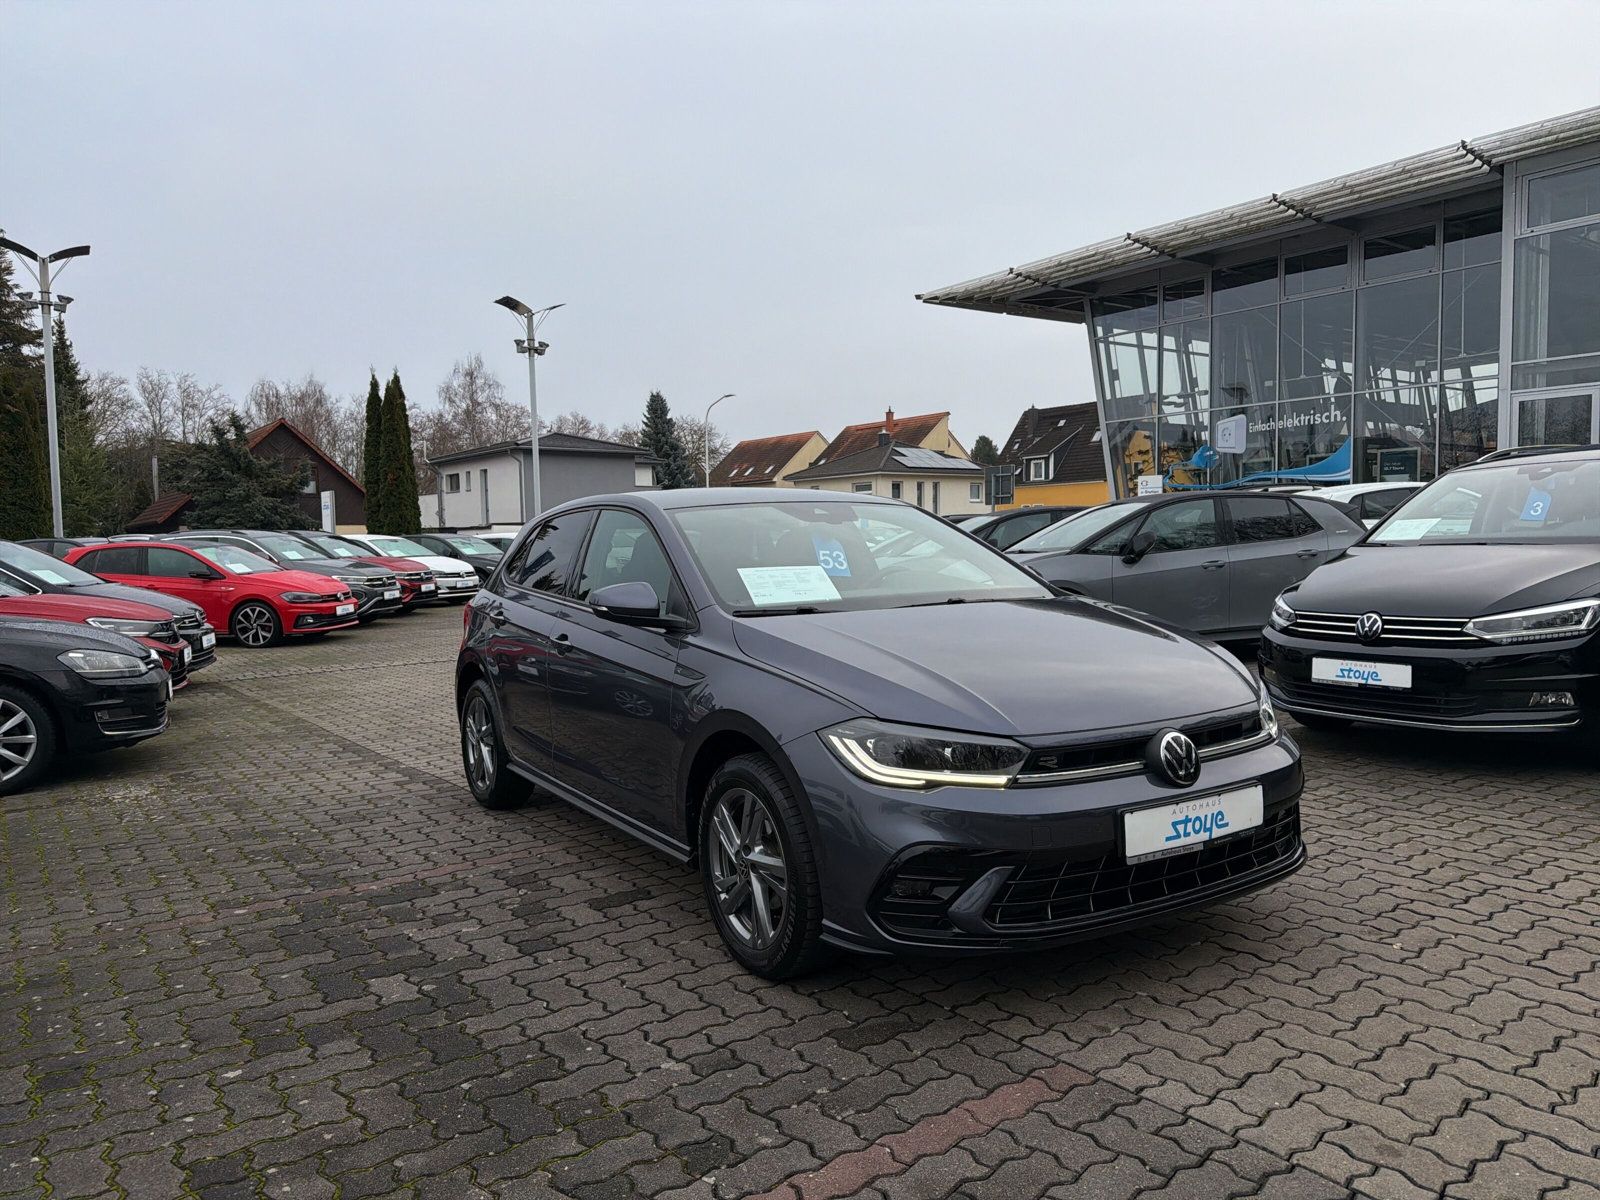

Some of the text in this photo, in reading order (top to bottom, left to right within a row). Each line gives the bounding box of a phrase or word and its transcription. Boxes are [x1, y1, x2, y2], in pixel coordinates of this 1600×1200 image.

[1248, 404, 1347, 433] Einfach elektrisch.
[1530, 502, 1543, 516] 3
[819, 550, 847, 570] 53
[1172, 798, 1222, 815] AUTOHAUS
